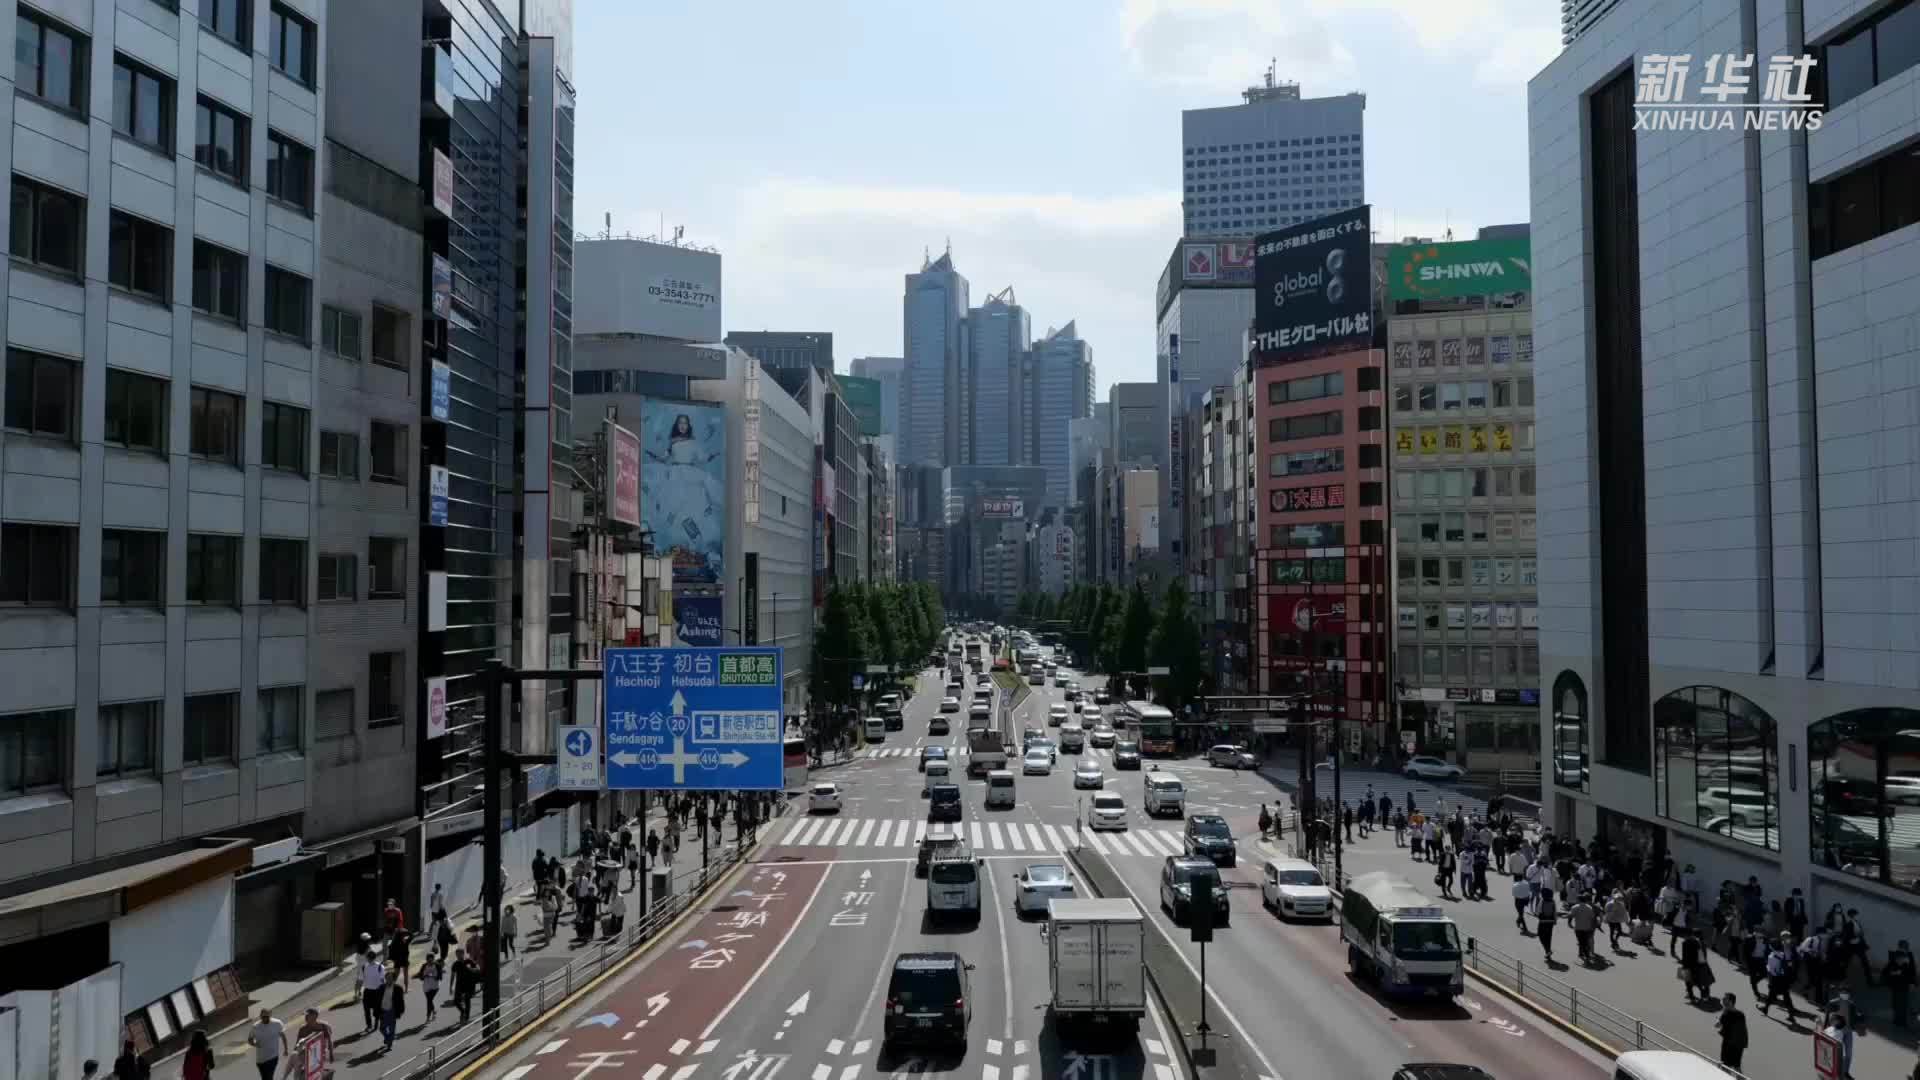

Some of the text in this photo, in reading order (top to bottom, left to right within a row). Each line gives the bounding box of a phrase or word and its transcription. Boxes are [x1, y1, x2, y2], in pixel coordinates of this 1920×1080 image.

[1420, 261, 1504, 281] SHINWA
[1274, 265, 1323, 306] global
[648, 286, 715, 303] 03-3543-7771
[1256, 312, 1370, 351] THEグローバル社
[610, 653, 713, 674] 八王子 初台
[722, 656, 774, 673] 首都高
[615, 675, 715, 688] Hachioji Hatsudai
[721, 673, 757, 684] SHUTOKO
[671, 719, 685, 731] 20
[609, 734, 664, 746] Sendagaya
[640, 753, 657, 765] 414
[700, 753, 718, 765] 414
